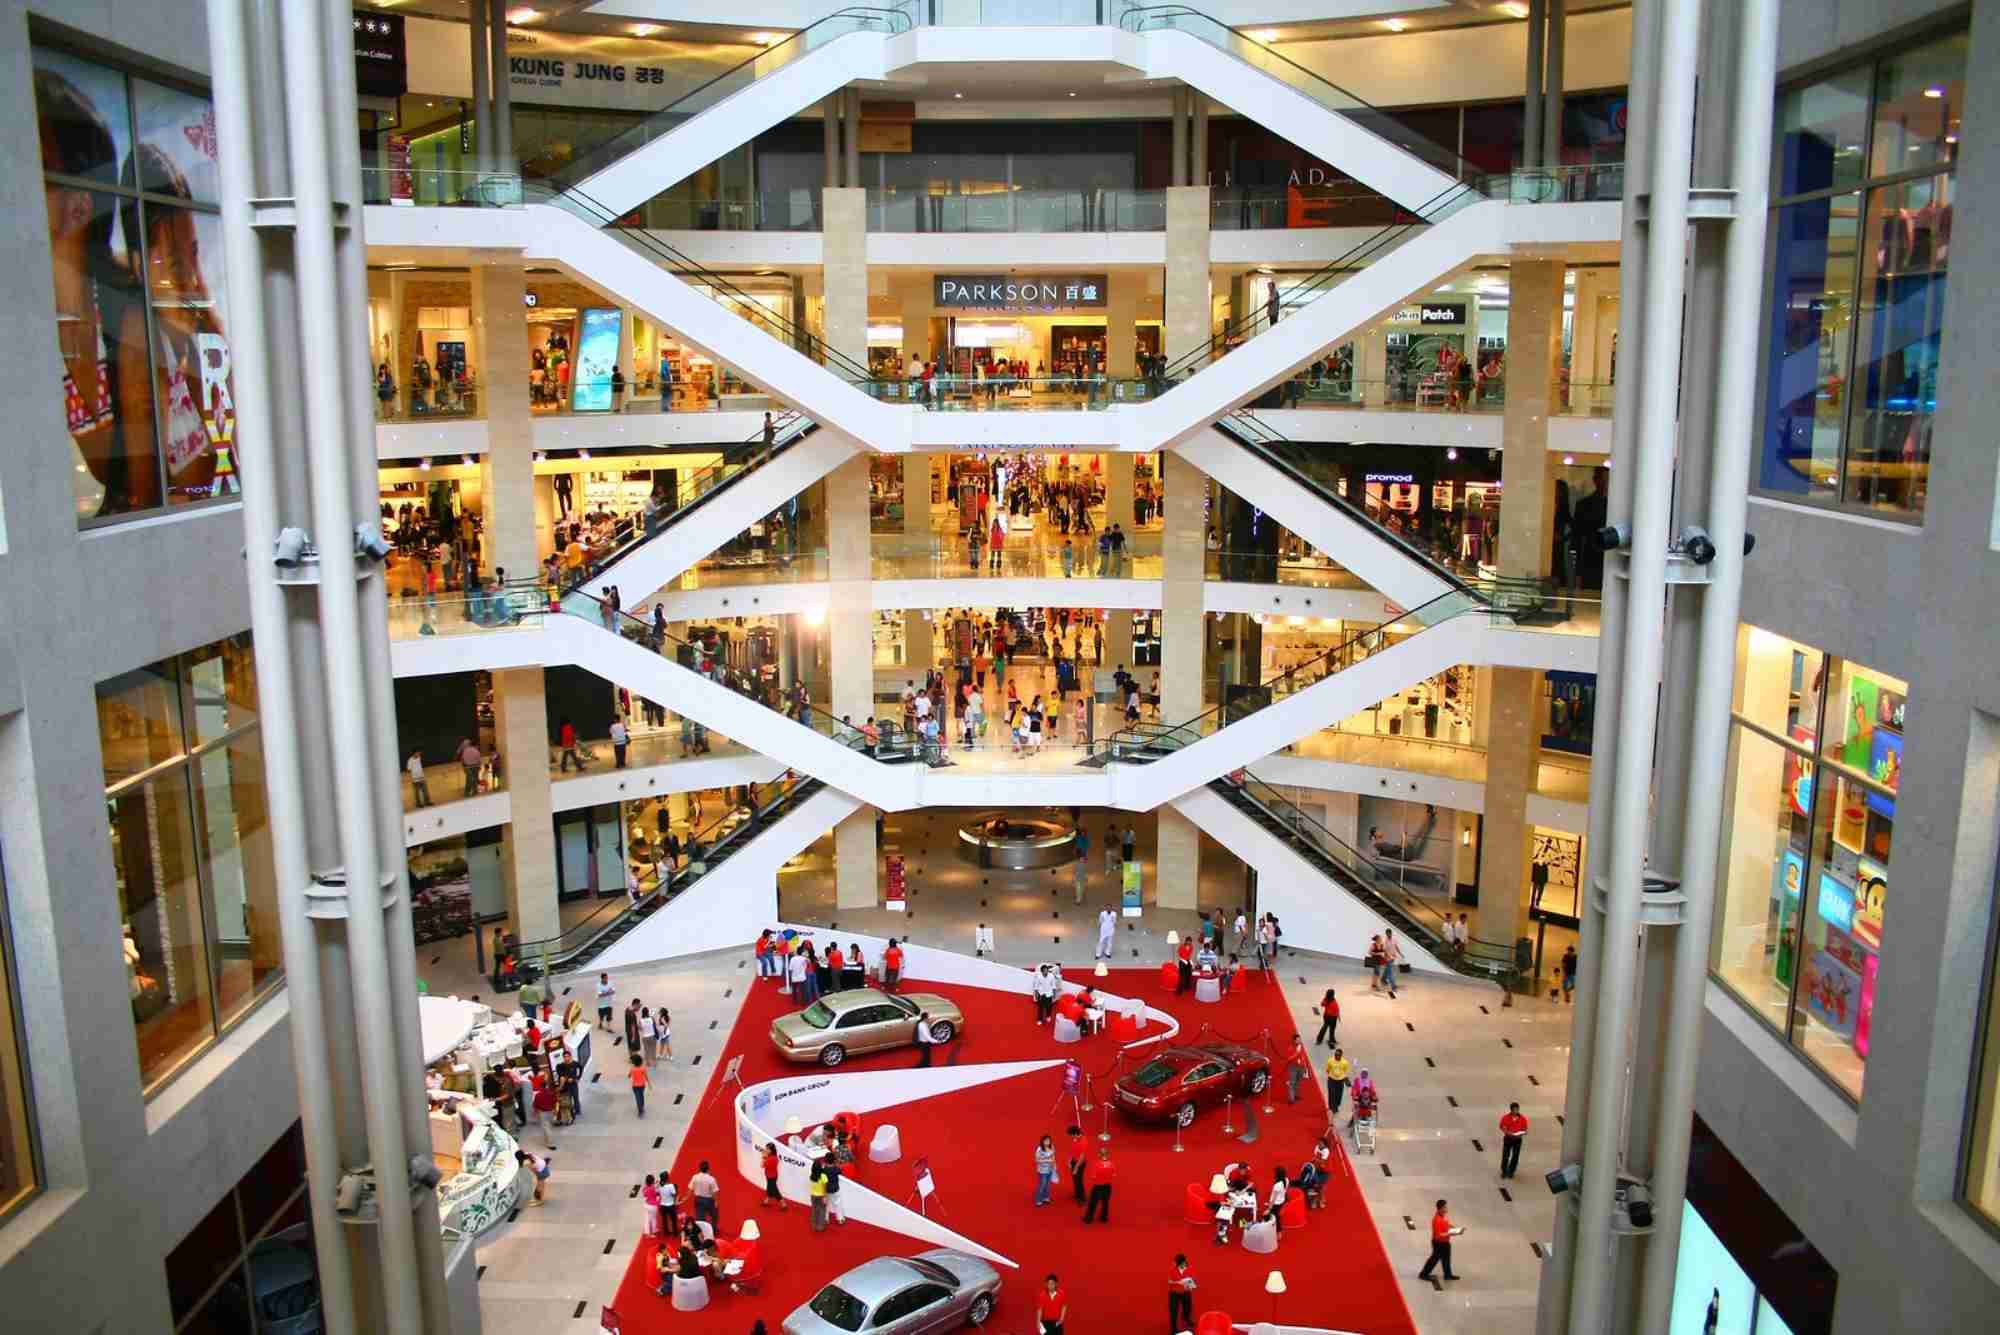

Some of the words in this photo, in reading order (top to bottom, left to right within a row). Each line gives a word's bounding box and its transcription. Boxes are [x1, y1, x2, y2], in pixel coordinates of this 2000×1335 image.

[510, 57, 564, 77] KUNG
[574, 63, 625, 81] JUNG
[941, 281, 1058, 301] PARKSON
[1064, 284, 1098, 301] 百盛
[1423, 309, 1455, 320] Patch
[1366, 473, 1413, 482] promod
[788, 1086, 806, 1096] BANK
[807, 1080, 831, 1090] GROUP
